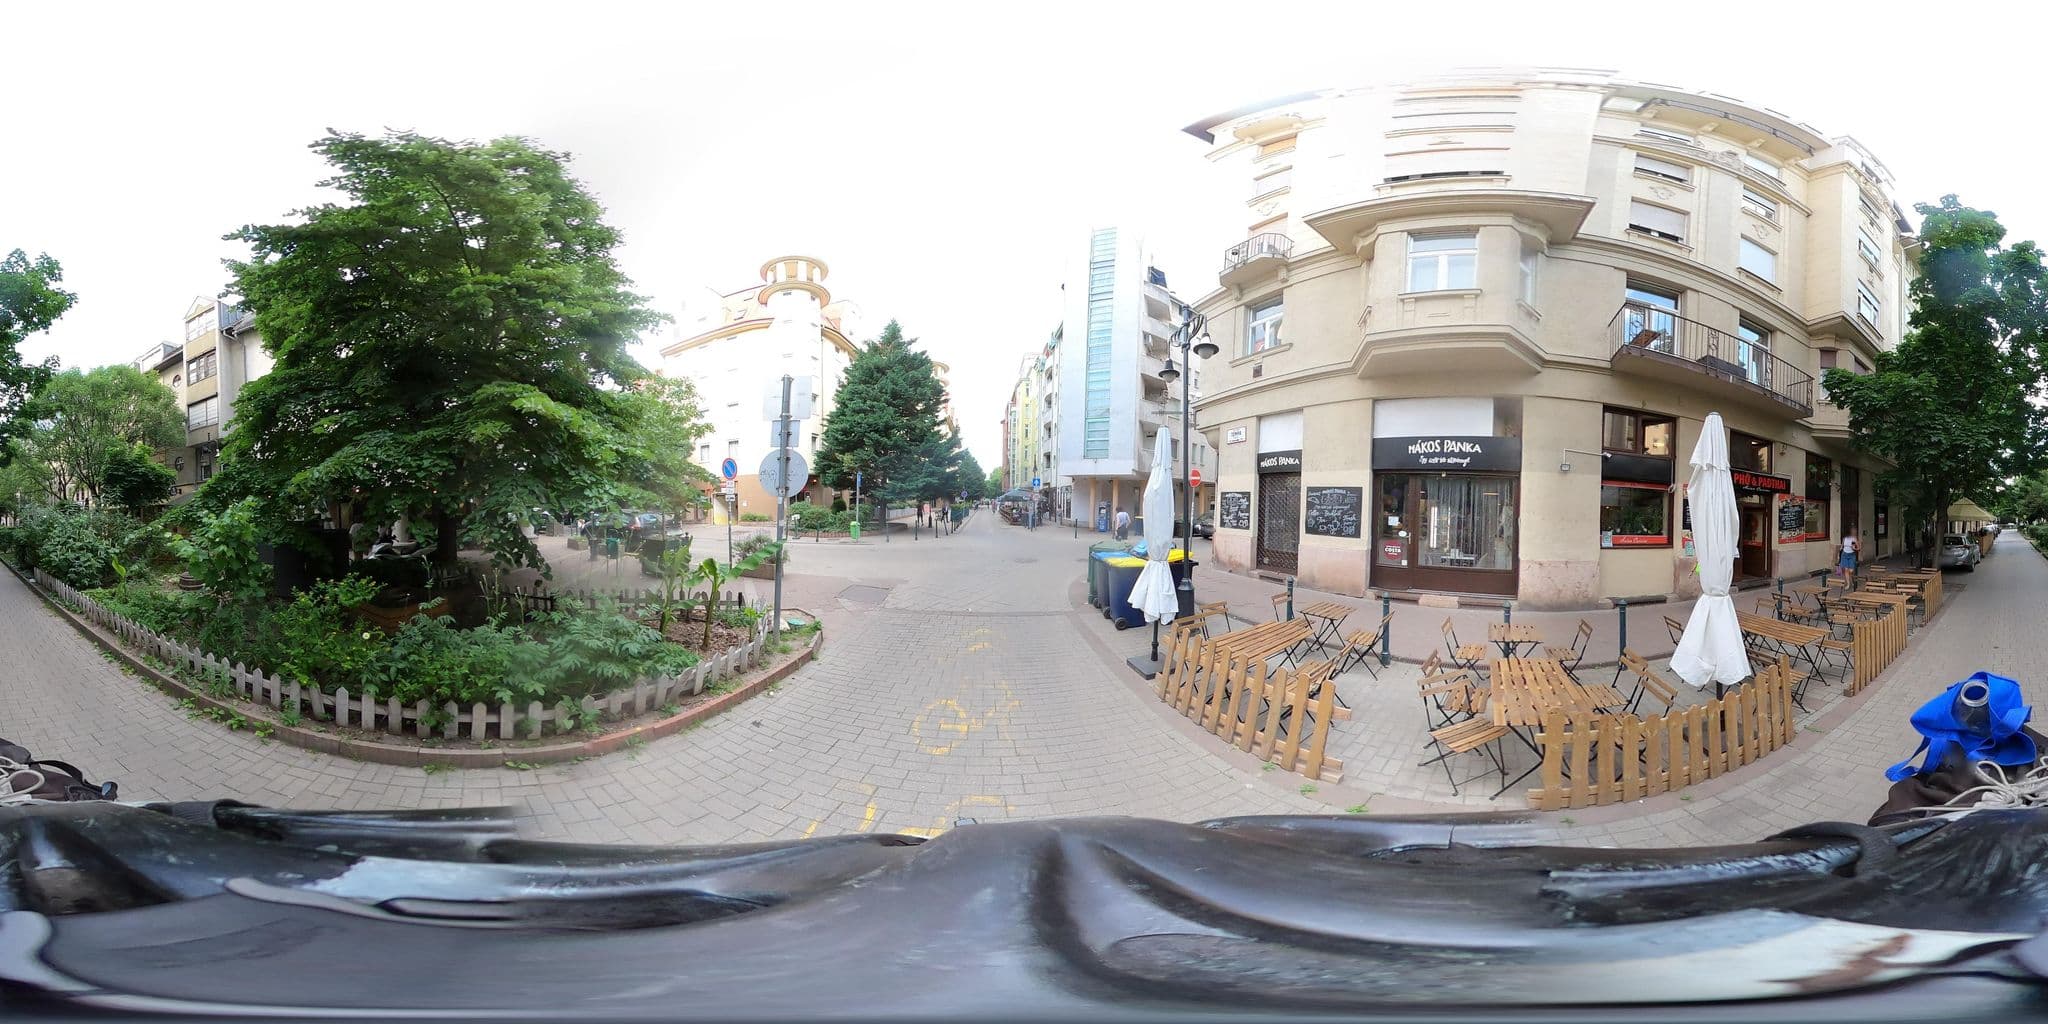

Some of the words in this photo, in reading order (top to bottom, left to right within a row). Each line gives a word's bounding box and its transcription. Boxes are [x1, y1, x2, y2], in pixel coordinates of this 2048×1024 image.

[1408, 440, 1441, 454] MÁKOS
[1443, 440, 1482, 453] PANKA
[1279, 457, 1300, 465] PANKA
[1758, 477, 1786, 489] PADTHAI
